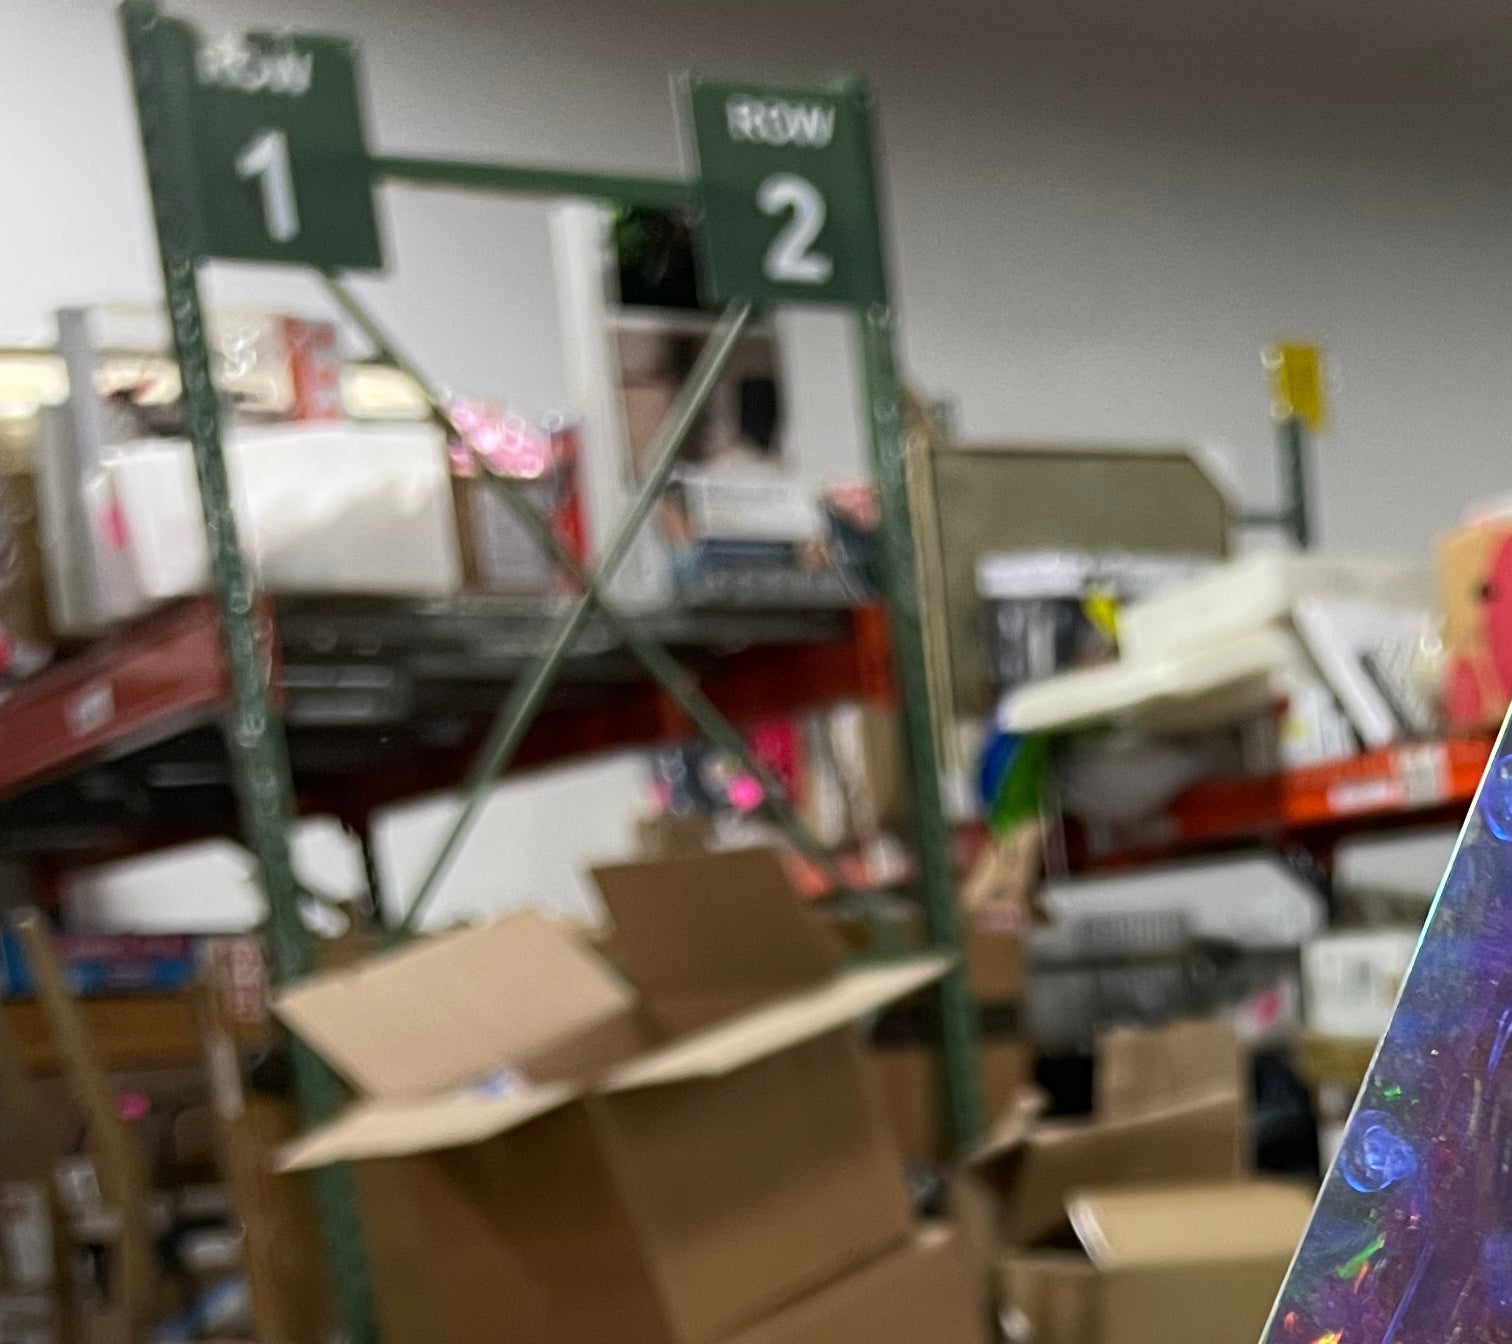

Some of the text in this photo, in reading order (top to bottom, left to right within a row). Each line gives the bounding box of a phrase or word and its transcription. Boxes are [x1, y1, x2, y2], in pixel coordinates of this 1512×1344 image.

[725, 95, 837, 147] ROW
[235, 129, 299, 241] 1
[756, 172, 834, 284] 2
